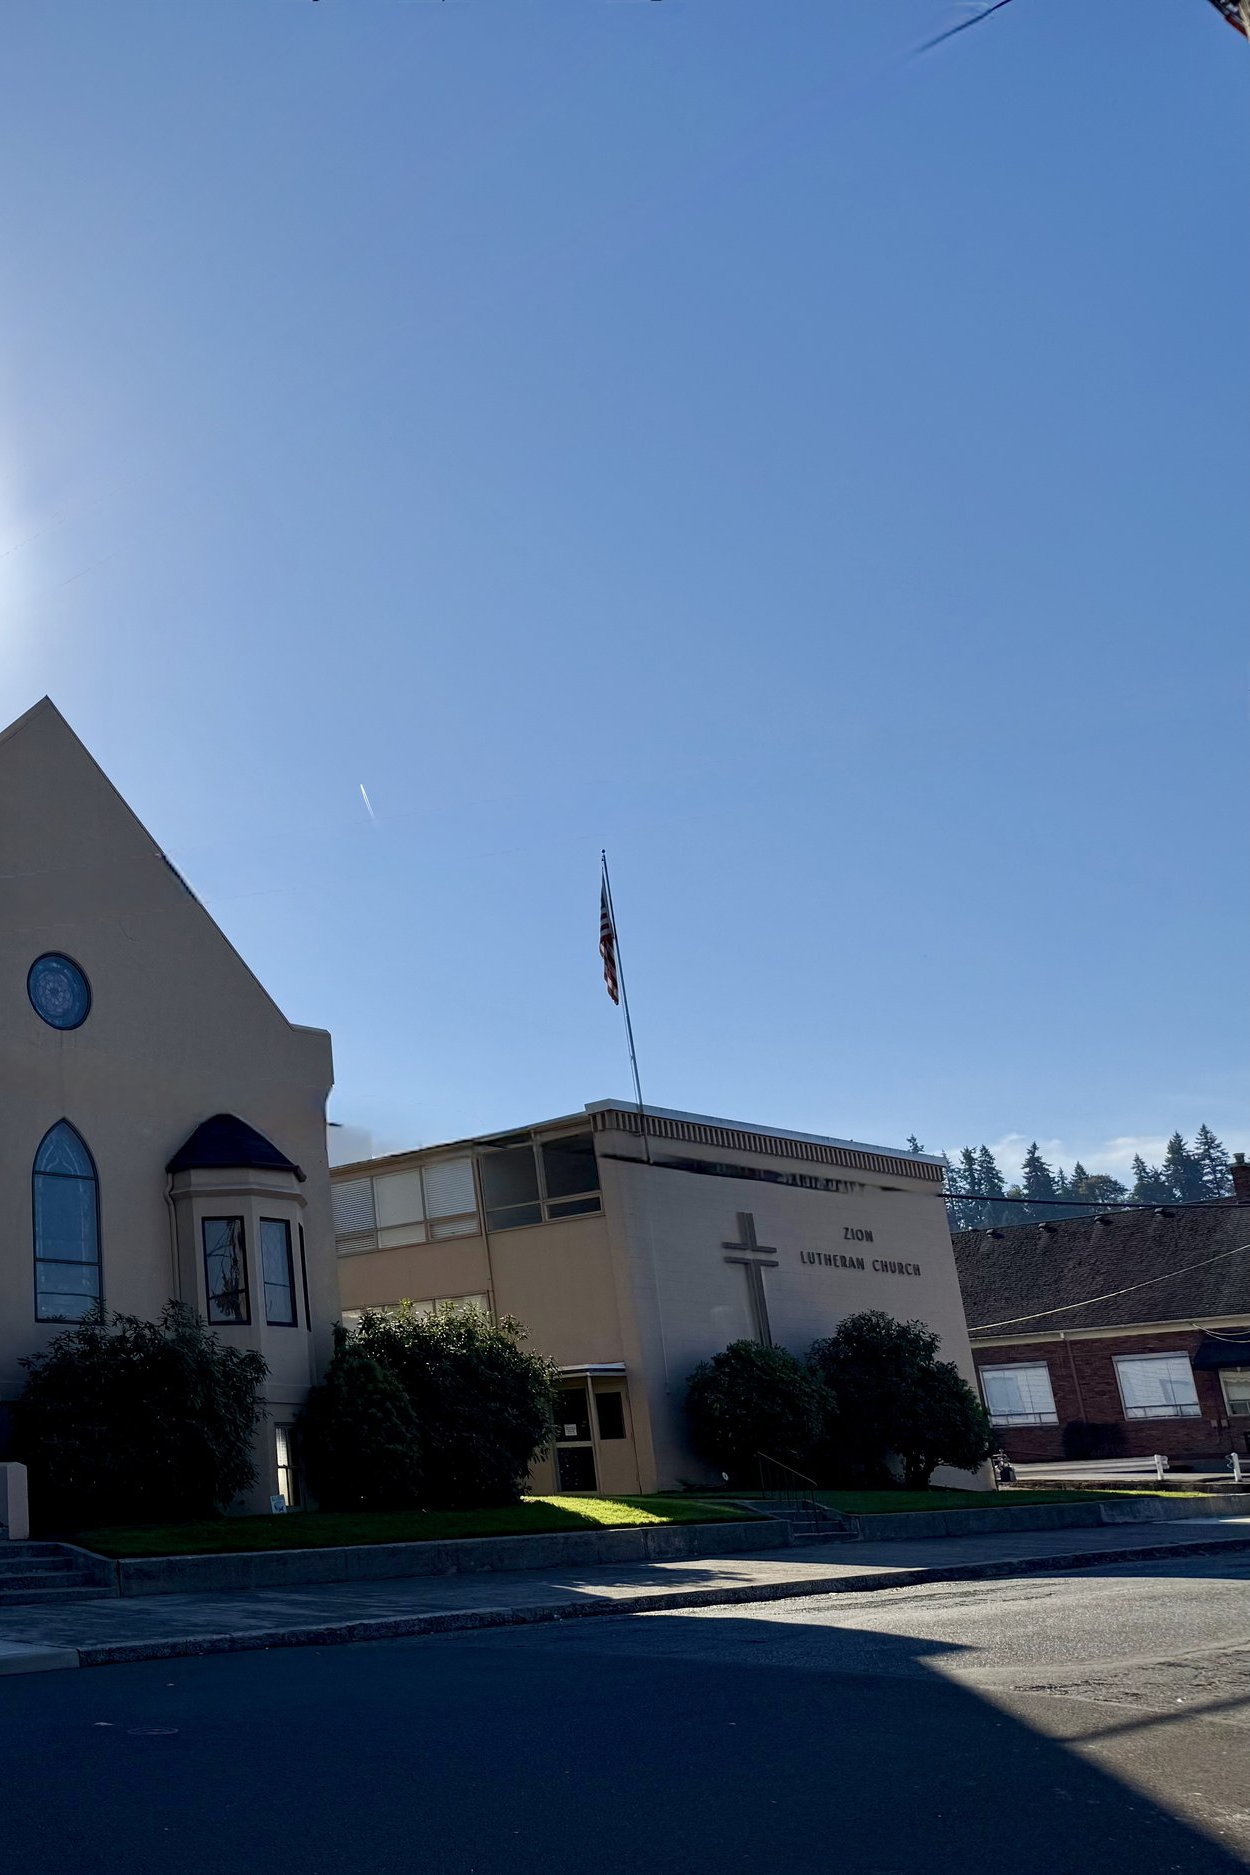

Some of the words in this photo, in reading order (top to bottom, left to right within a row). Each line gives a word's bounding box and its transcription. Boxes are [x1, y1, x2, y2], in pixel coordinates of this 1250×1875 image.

[843, 1227, 874, 1242] ZION
[800, 1251, 865, 1270] LUTHERAN
[872, 1260, 921, 1276] CHURCH
